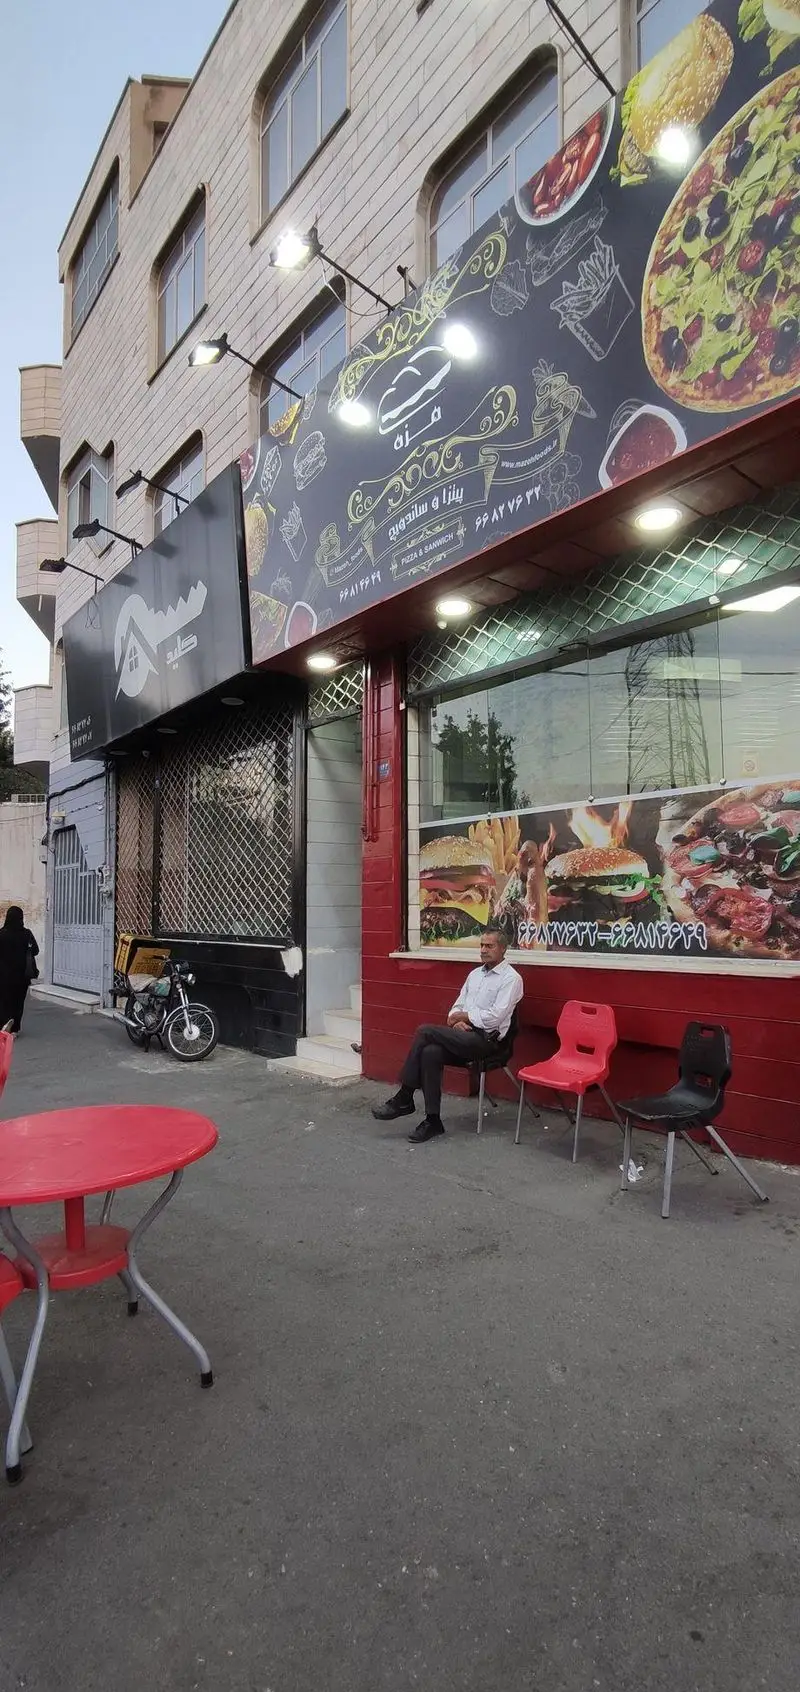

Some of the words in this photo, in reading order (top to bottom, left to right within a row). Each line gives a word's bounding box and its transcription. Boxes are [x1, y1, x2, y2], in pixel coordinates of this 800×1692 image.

[393, 405, 442, 451] مزه
[431, 495, 439, 510] و
[442, 483, 464, 506] پیتزا
[388, 502, 428, 542] ساندویچ
[400, 550, 418, 566] PIZZA
[424, 532, 454, 555] SANWICH
[166, 633, 198, 670] کلید
